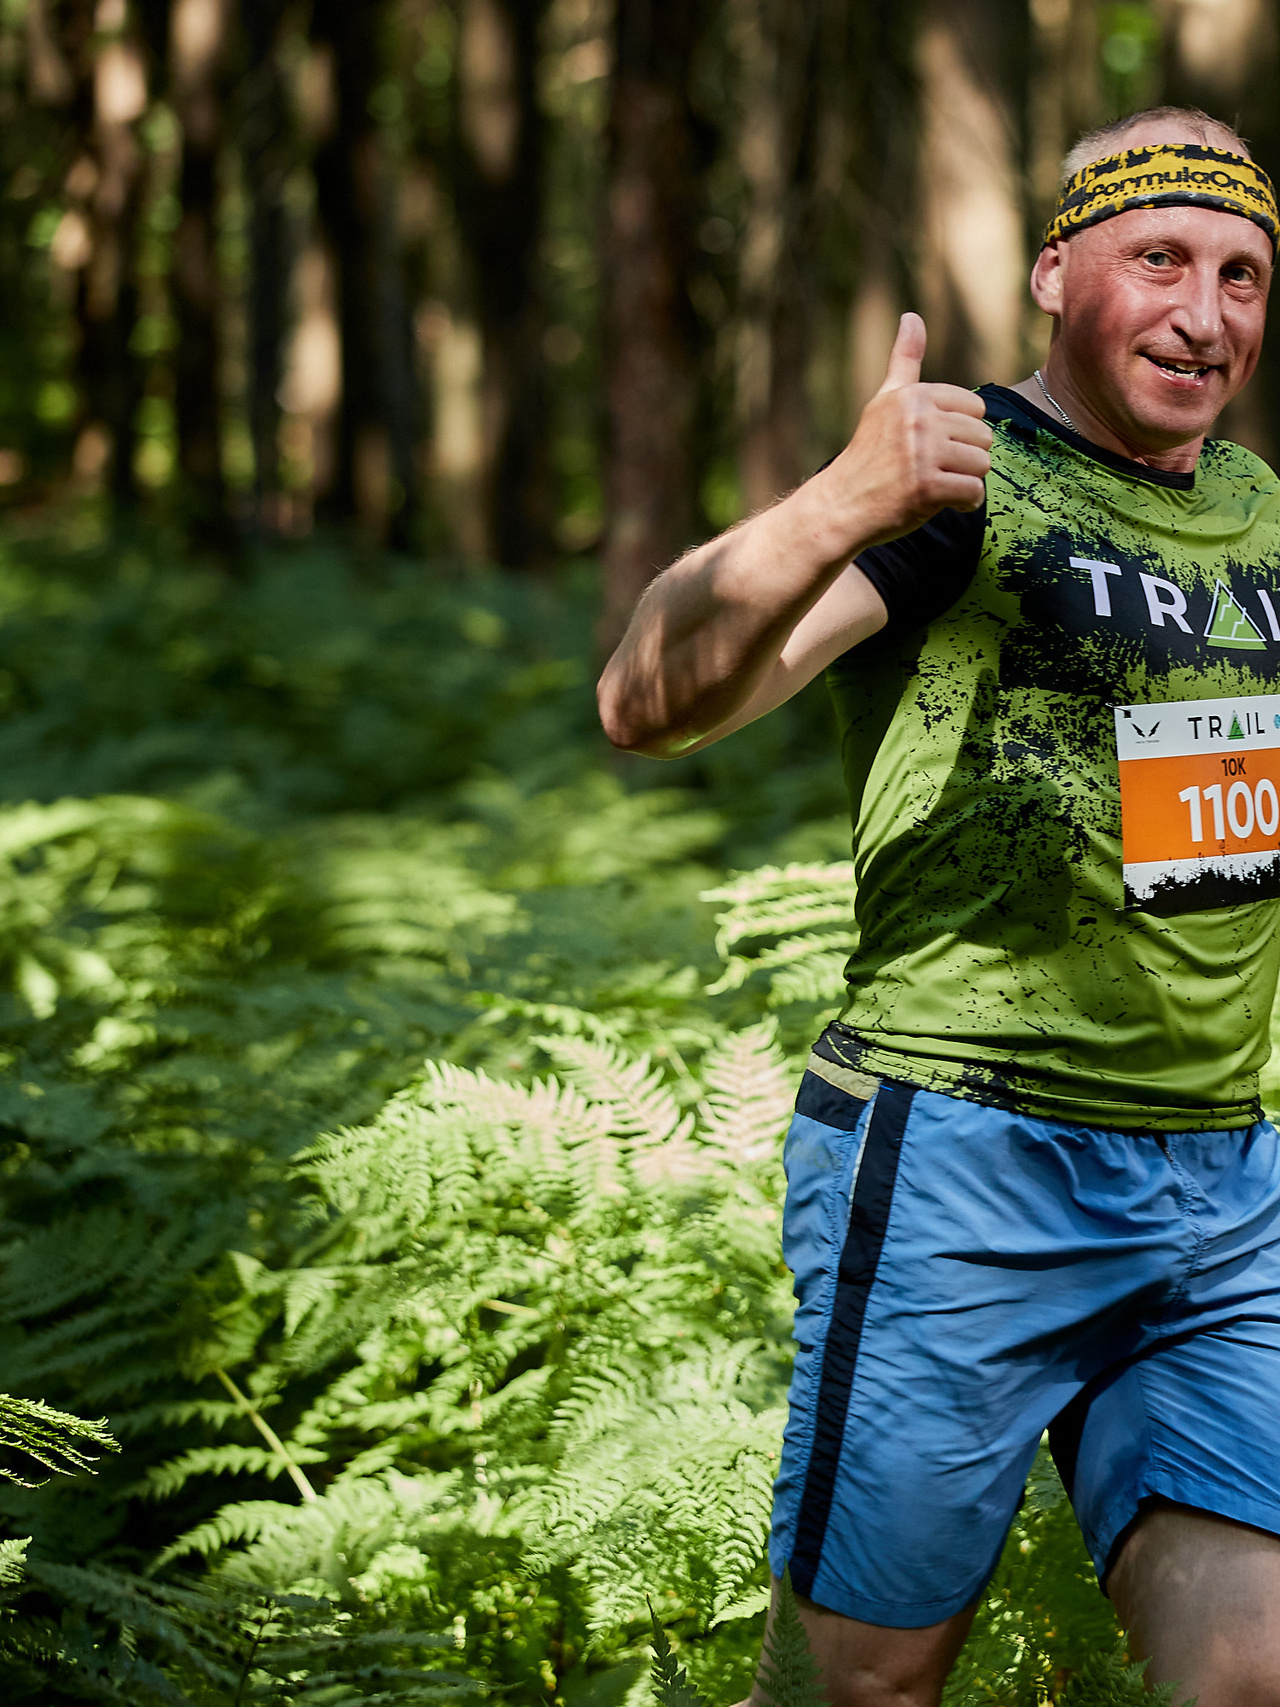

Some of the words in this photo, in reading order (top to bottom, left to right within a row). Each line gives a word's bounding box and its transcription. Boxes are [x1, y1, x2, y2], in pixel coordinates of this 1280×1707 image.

[1187, 709, 1265, 741] TRAIL
[1221, 757, 1247, 776] 10K
[1178, 778, 1280, 842] 1100
